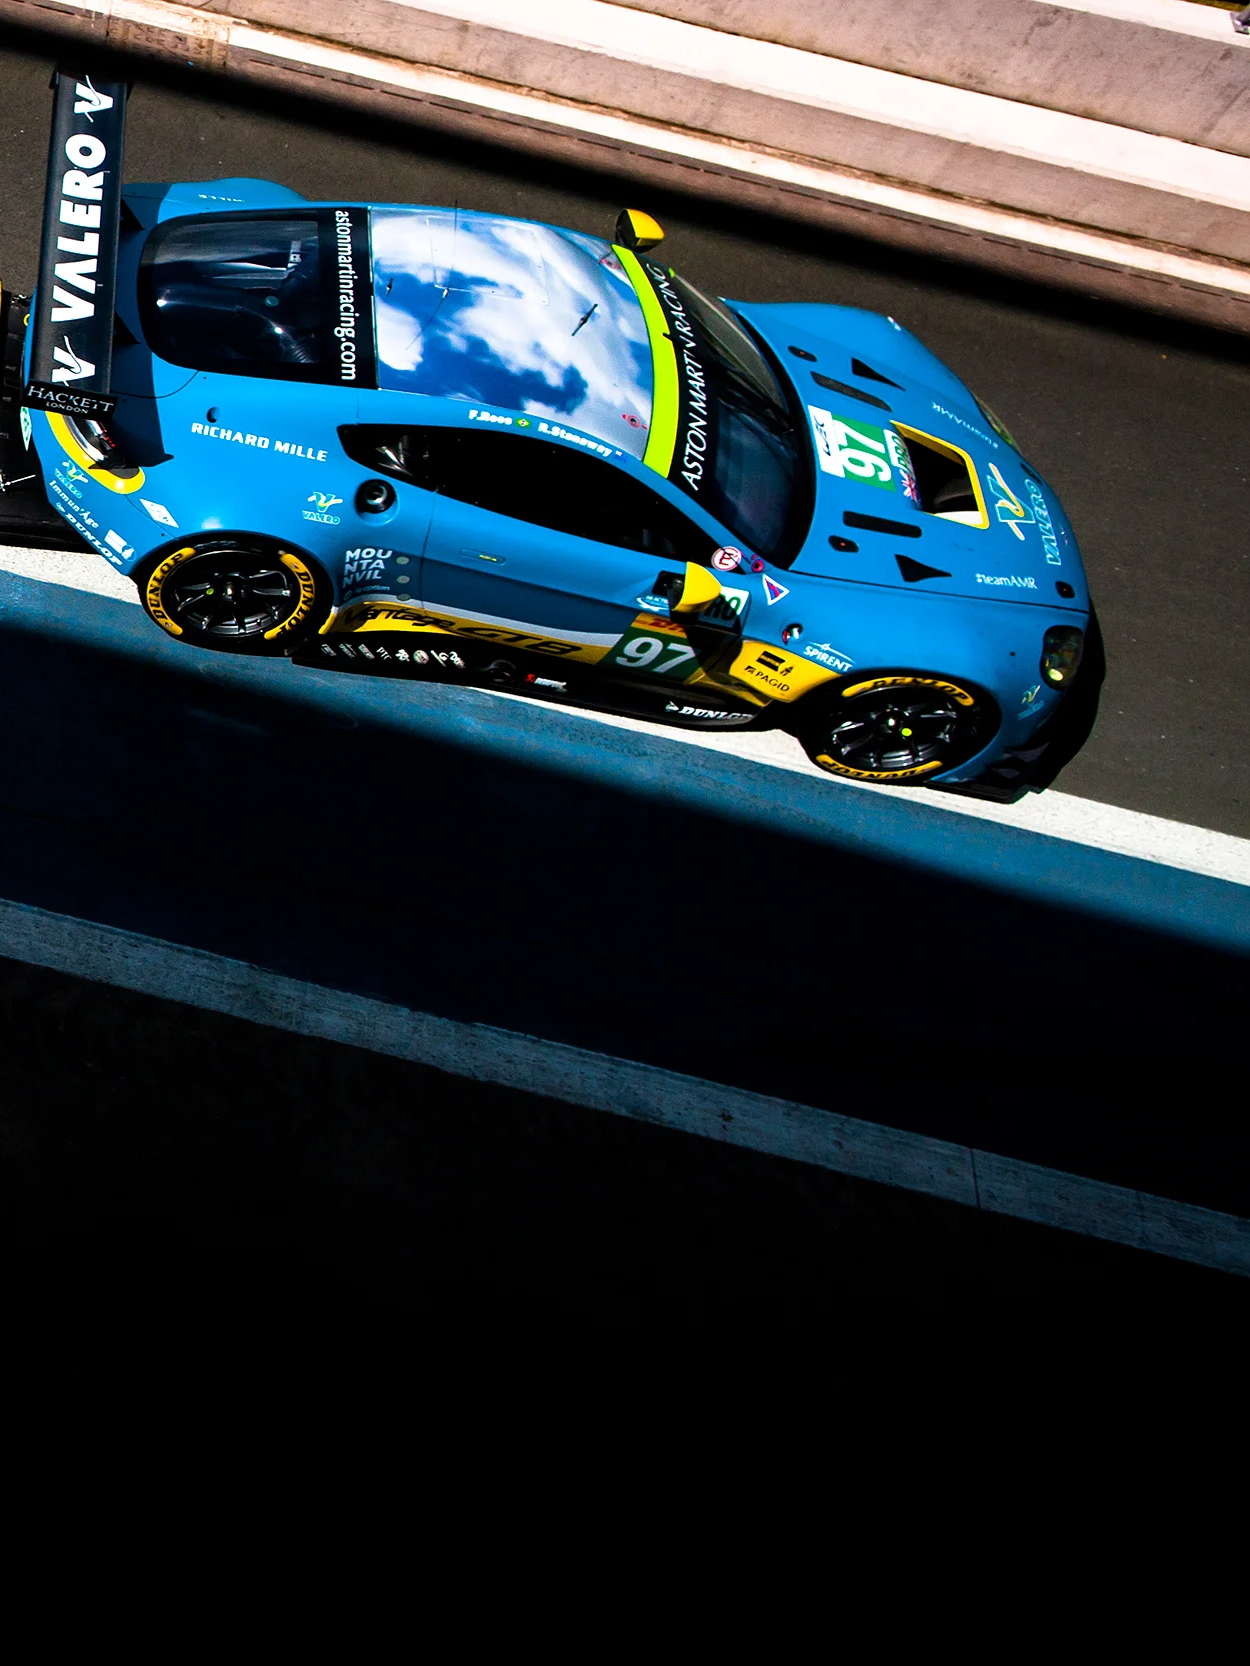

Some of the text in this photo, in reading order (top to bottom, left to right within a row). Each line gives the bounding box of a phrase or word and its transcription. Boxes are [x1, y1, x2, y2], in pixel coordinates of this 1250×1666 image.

[50, 133, 107, 323] VALERO
[333, 210, 360, 381] astonmartinracing.com
[646, 263, 694, 338] RACING
[27, 385, 114, 412] HACKETT
[46, 401, 89, 414] LONDON
[191, 422, 329, 462] RICHARD MILLE
[681, 413, 708, 491] ASTON
[833, 419, 892, 482] 97
[302, 510, 341, 525] VALERO
[1025, 478, 1063, 566] VALERO
[65, 512, 123, 566] DUNLOP
[345, 547, 393, 563] MOU
[149, 552, 183, 621] DUNLOP
[342, 569, 383, 589] NVIL
[344, 559, 386, 577] NTA
[975, 572, 1038, 589] #teamAMR
[276, 571, 315, 638] DUNLOP
[615, 637, 697, 674] 97
[803, 645, 853, 672] SPIRENT
[755, 671, 790, 692] PAGID
